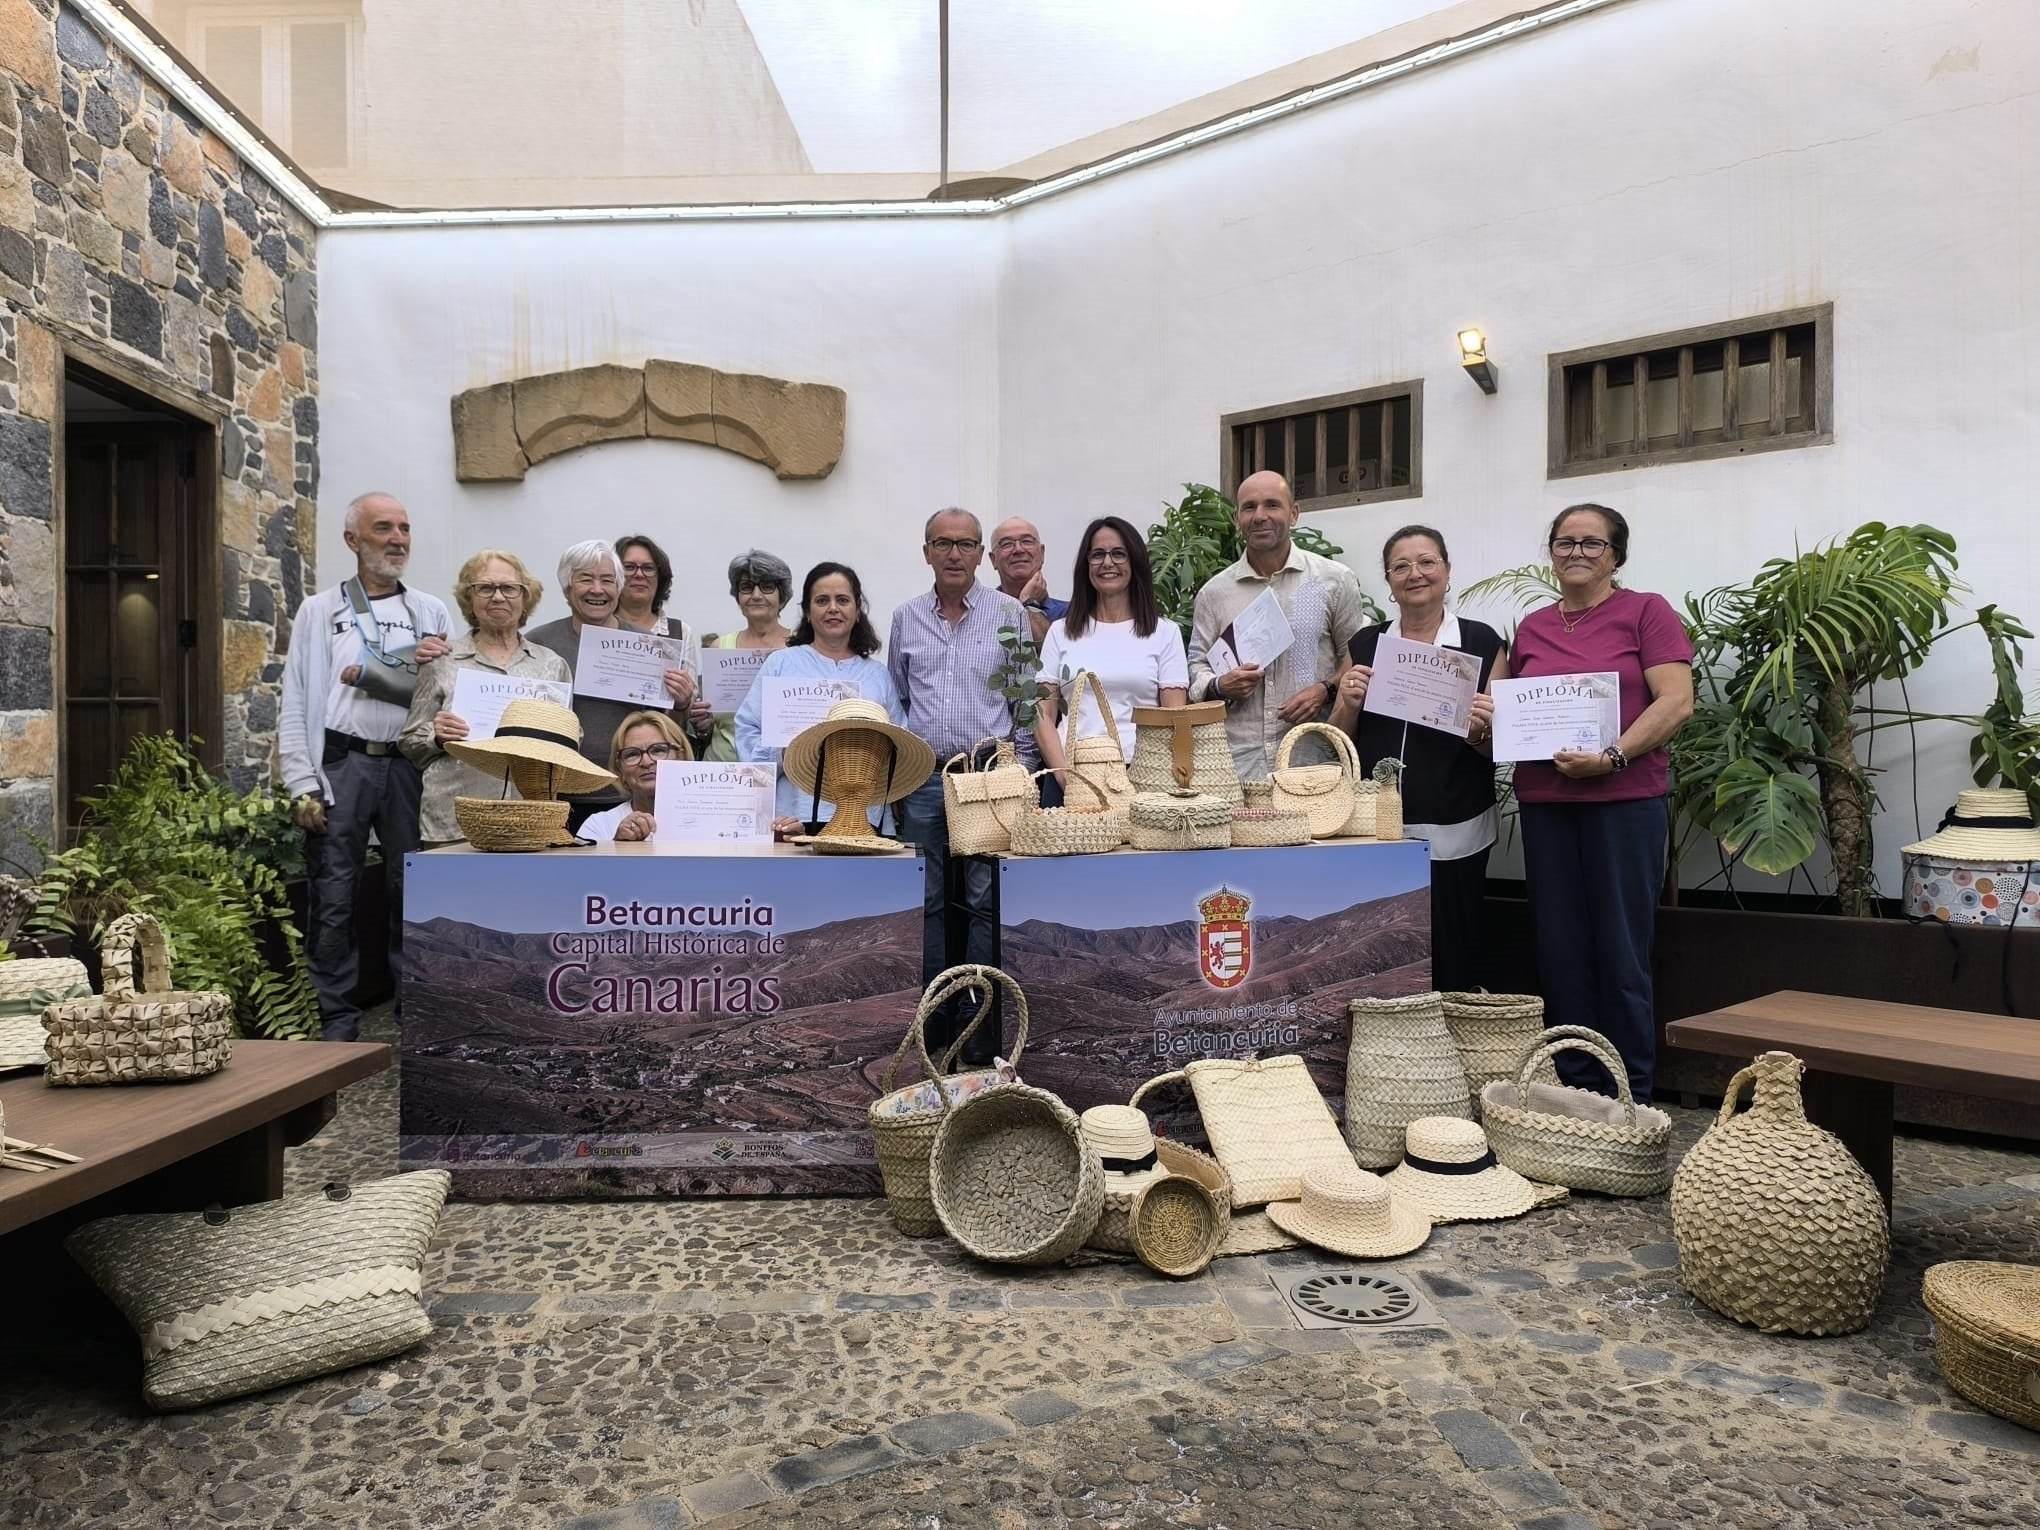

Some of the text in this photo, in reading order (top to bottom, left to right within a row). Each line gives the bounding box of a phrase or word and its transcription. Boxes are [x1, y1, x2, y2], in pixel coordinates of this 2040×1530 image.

[601, 639, 662, 659] DIPLOMA
[720, 656, 766, 669] DIPLOM
[1397, 653, 1460, 678] DIPLOMA
[480, 684, 548, 701] DIPLOMA
[782, 686, 843, 701] DIPLOMA
[1516, 685, 1593, 705] DIPLOMA
[681, 772, 753, 788] DIPLOMA
[586, 895, 773, 926] Betancuria
[552, 931, 785, 962] Capital Histórica de
[548, 963, 781, 1013] Canarias
[1153, 999, 1299, 1029] Ayuntamiento de
[1154, 1021, 1299, 1056] Betancuria
